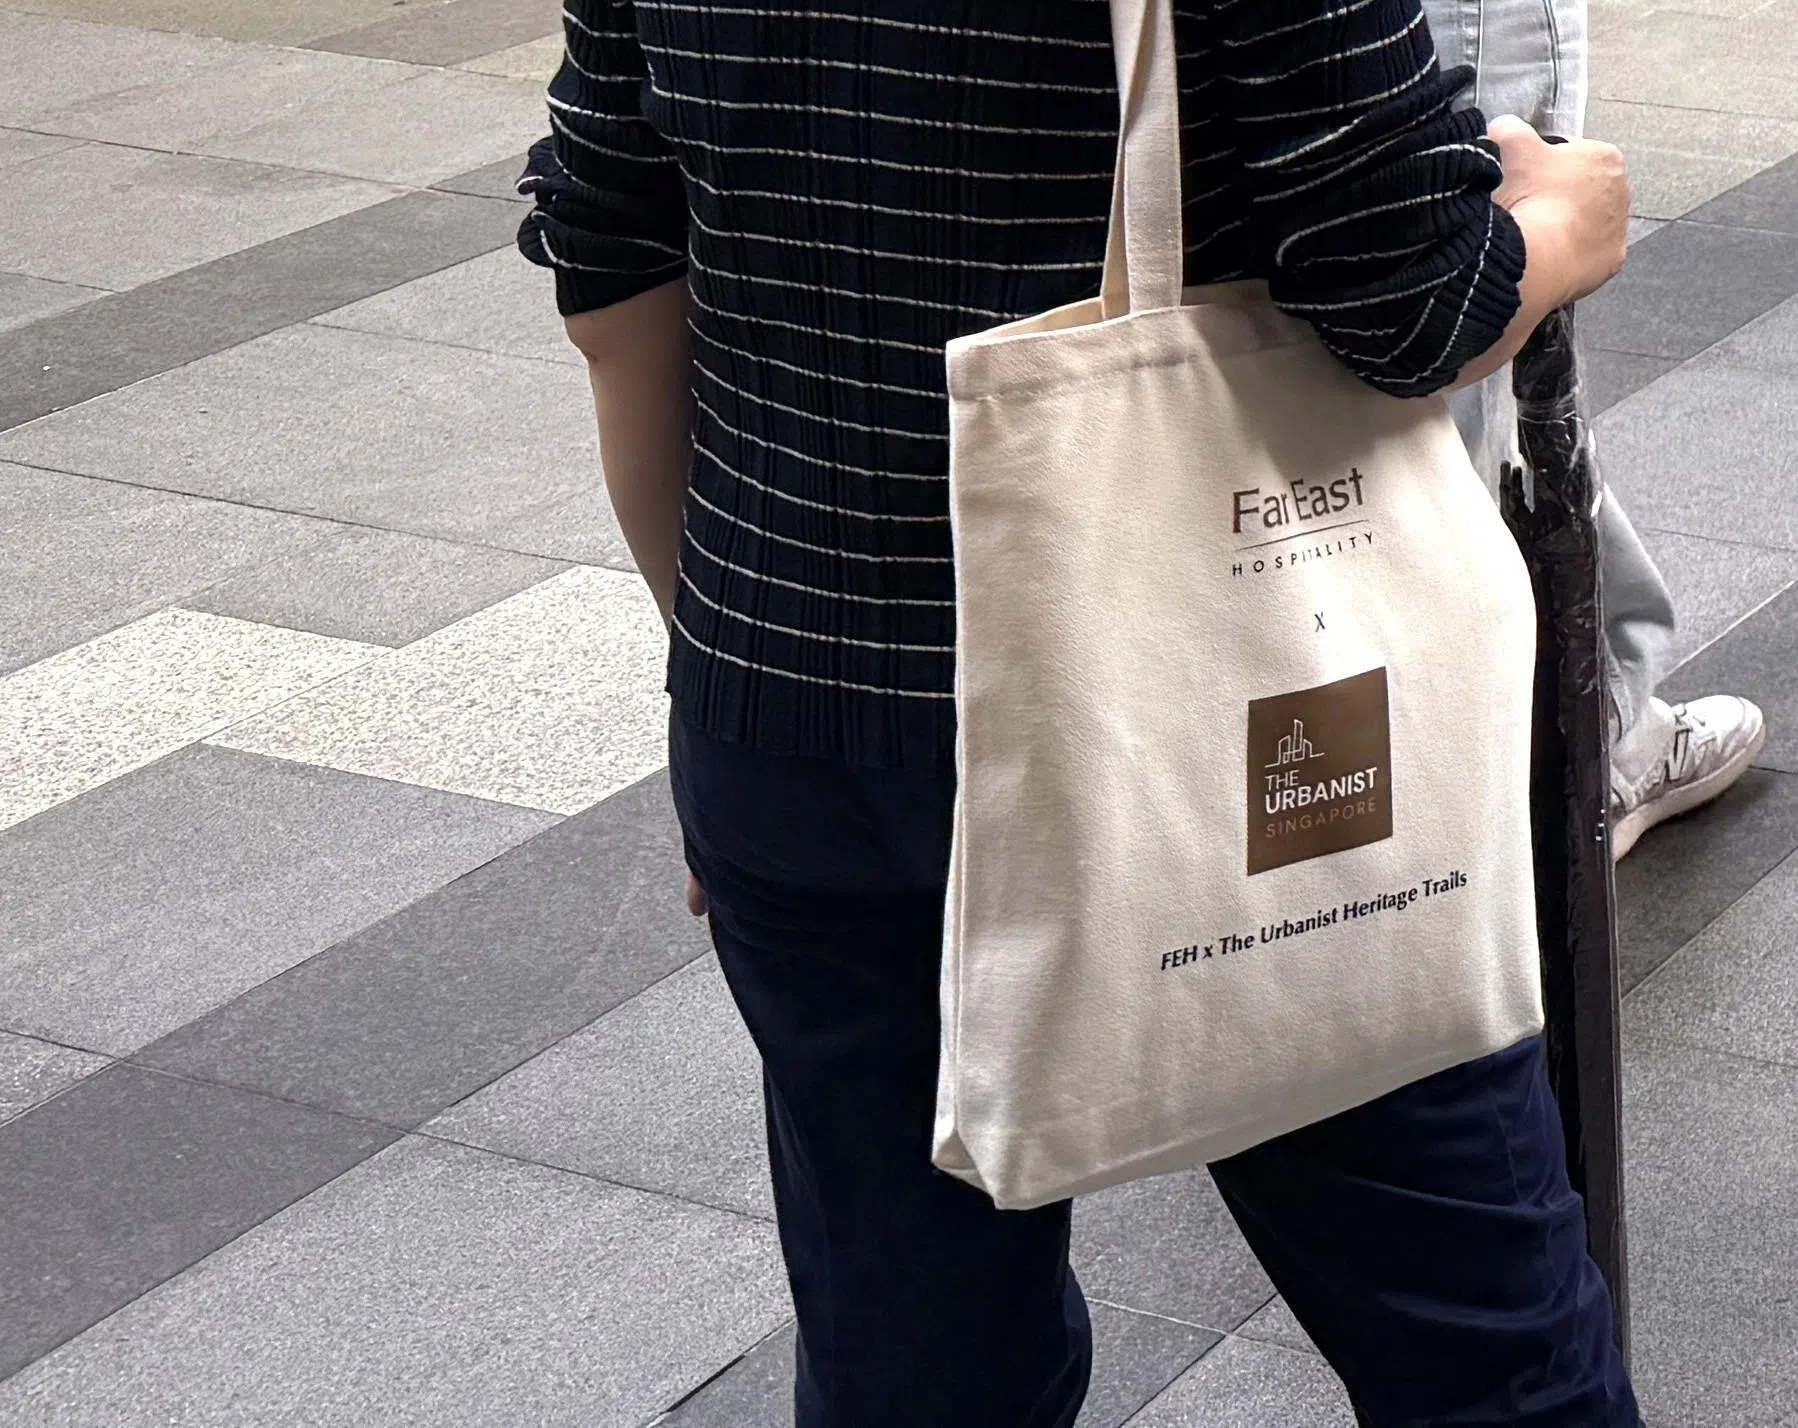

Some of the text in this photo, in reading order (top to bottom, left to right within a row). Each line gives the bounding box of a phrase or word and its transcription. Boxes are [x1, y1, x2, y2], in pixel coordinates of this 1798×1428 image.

[1233, 531, 1373, 576] HOSPITALITY
[1265, 769, 1300, 793] THE
[1265, 766, 1378, 815] URBANIST
[1265, 797, 1378, 839] SINGAPORE
[1161, 869, 1467, 972] FEH x The Urbanist Heritage Trails
